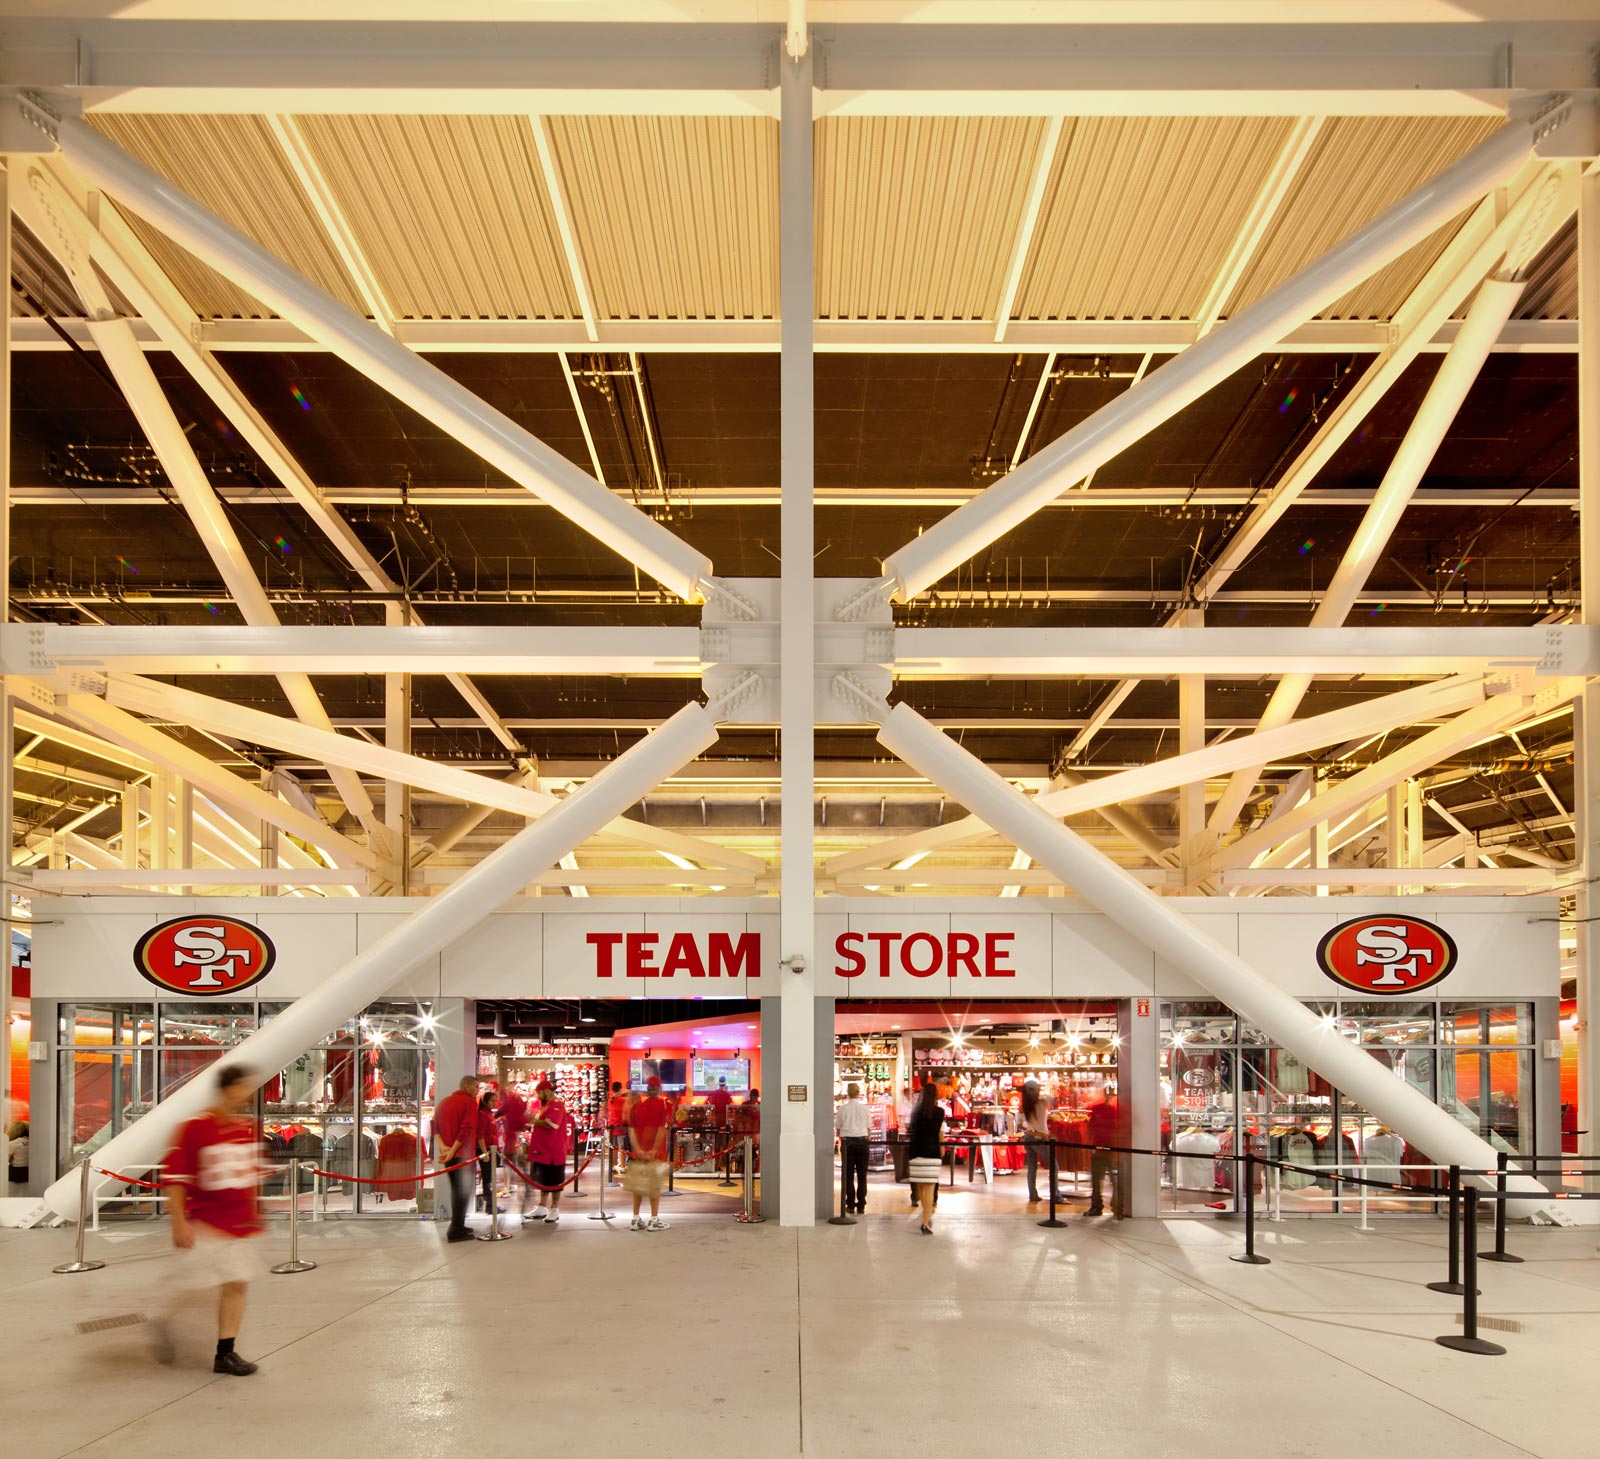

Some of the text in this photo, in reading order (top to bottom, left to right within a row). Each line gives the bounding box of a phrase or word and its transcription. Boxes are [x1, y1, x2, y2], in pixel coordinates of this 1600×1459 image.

[173, 926, 250, 986] SF
[586, 931, 1016, 978] TEAM STORE
[1356, 925, 1432, 985] SF
[382, 1088, 412, 1096] TEAM
[1184, 1088, 1213, 1096] TEAM
[1184, 1097, 1215, 1105] STORE
[1189, 1113, 1210, 1121] VISA
